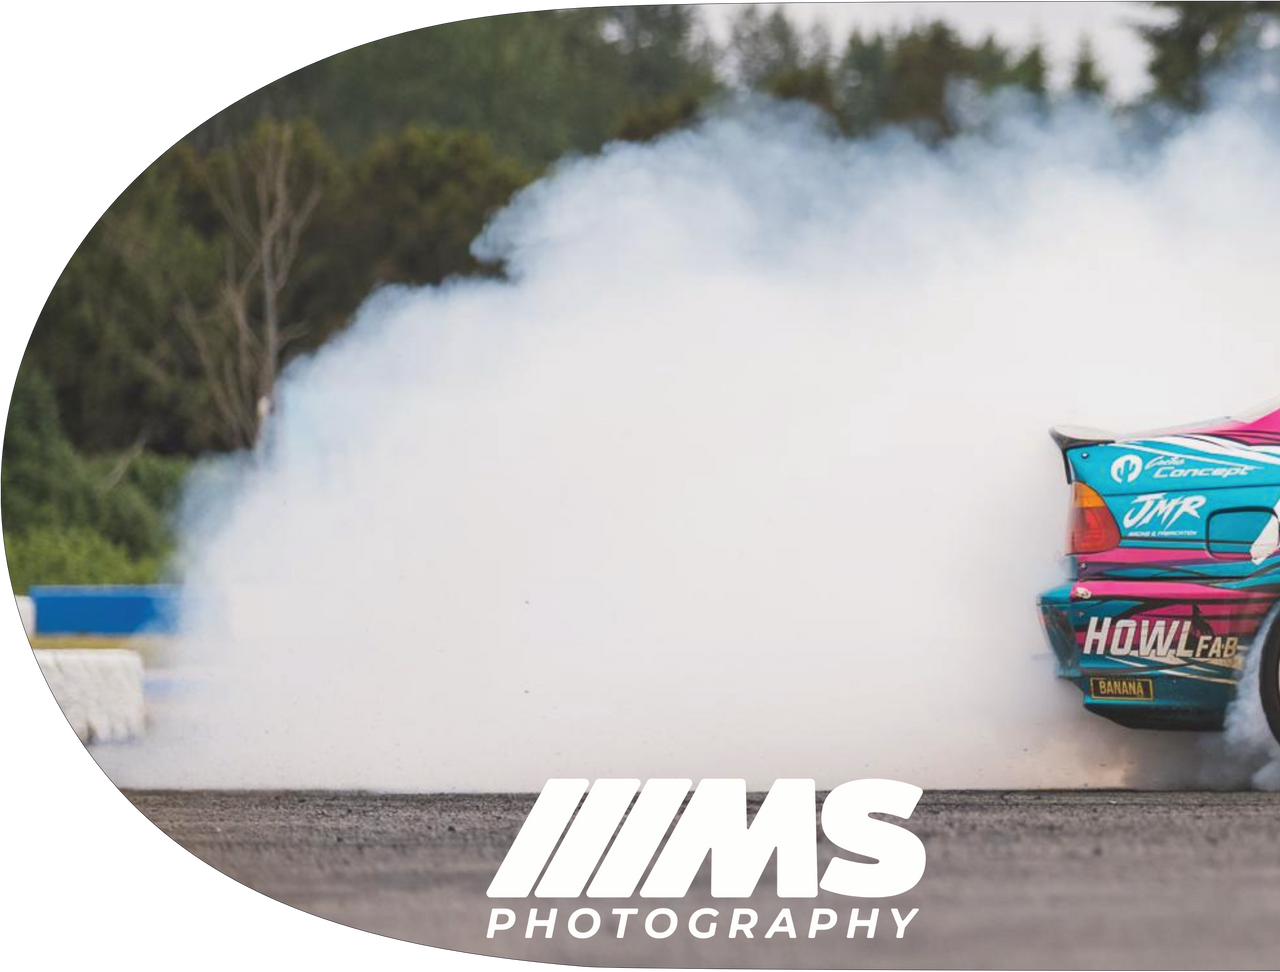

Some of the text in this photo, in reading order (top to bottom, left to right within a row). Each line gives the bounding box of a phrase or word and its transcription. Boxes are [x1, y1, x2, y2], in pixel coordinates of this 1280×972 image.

[1153, 465, 1256, 479] Concept
[1123, 492, 1206, 531] JMR
[1083, 616, 1239, 659] HOWL FAB
[1099, 680, 1144, 696] BANANA
